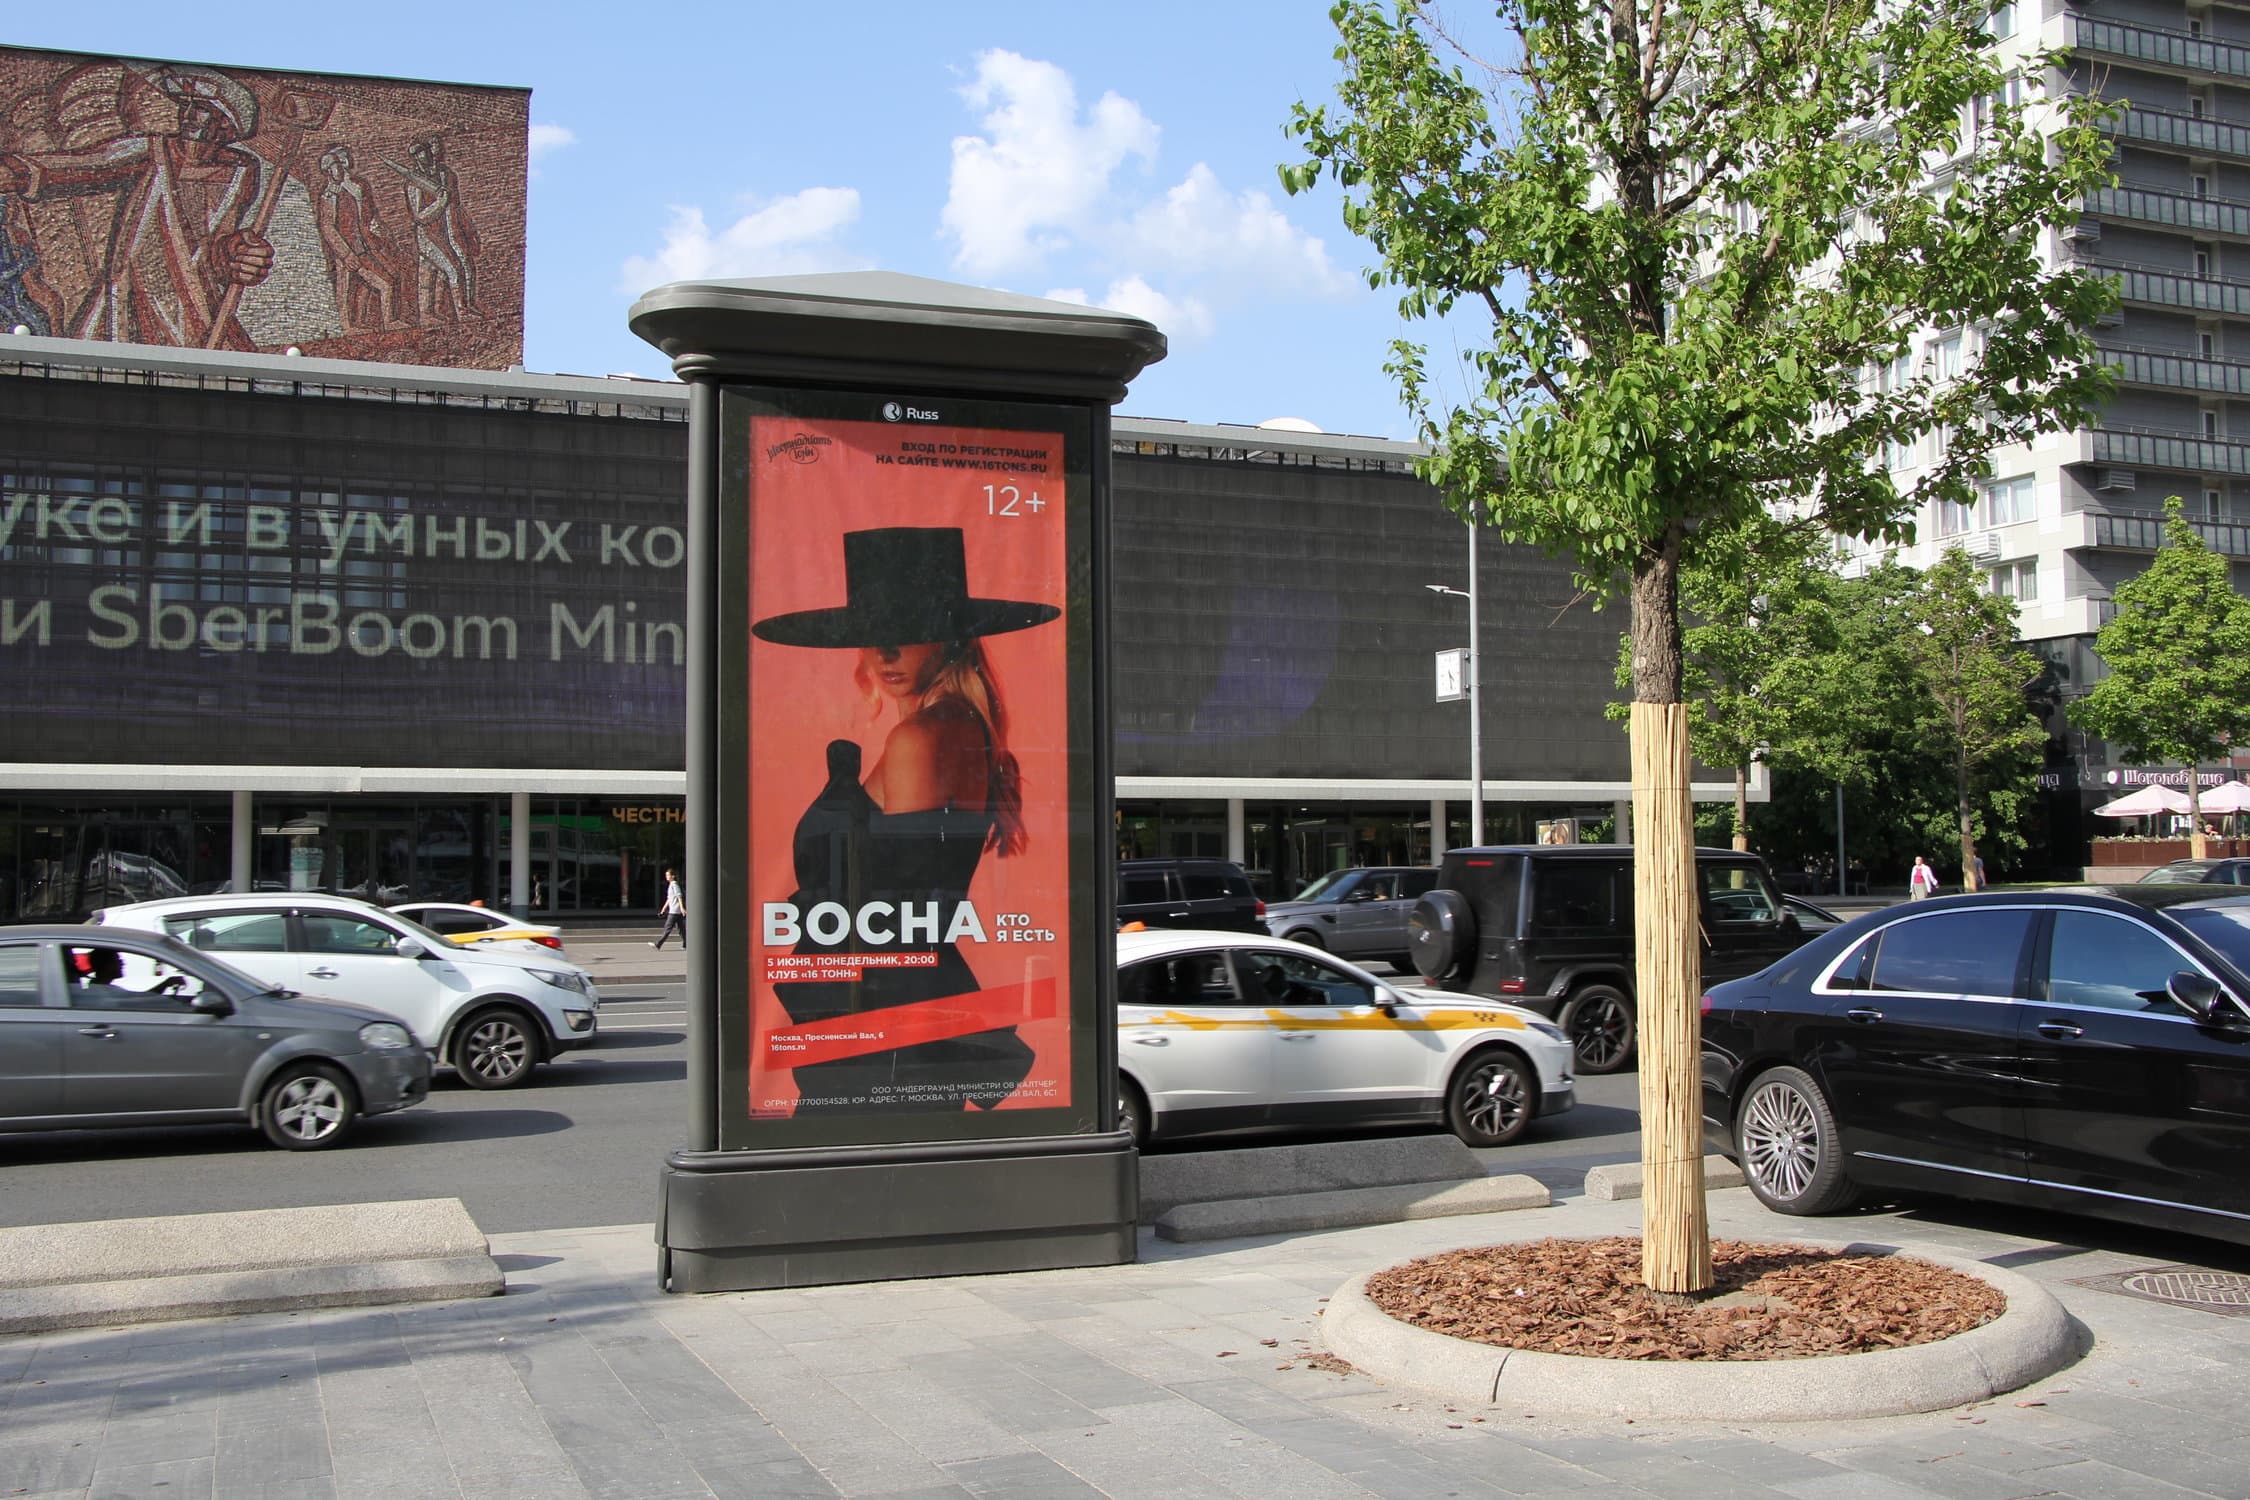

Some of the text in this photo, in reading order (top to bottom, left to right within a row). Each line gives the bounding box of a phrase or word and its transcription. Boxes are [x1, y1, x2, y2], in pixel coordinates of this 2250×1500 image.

[906, 407, 939, 421] Russ
[901, 442, 1047, 460] ВХОД ПО РЕГИСТРАЦИИ
[876, 455, 1047, 473] НА САЙТЕ WWW.16TONS.RU
[983, 484, 1046, 517] 12+
[167, 501, 212, 546] и
[246, 506, 290, 549] в
[315, 509, 573, 568] умных
[87, 584, 517, 661] SberBoom
[551, 601, 684, 666] Min
[763, 900, 988, 946] ВОСНА
[996, 914, 1030, 927] КТО
[996, 929, 1056, 943] Я ЕСТЬ
[767, 955, 936, 967] 5 ИЮНЯ, ПОНЕДЕЛЬНИК, 20:00
[767, 969, 858, 980] КЛУБ «16 ТОНН»
[771, 1032, 885, 1043] Москва, Пресненский Вал, 6
[771, 1044, 807, 1052] 16tons.ru
[871, 1086, 892, 1094] ООО
